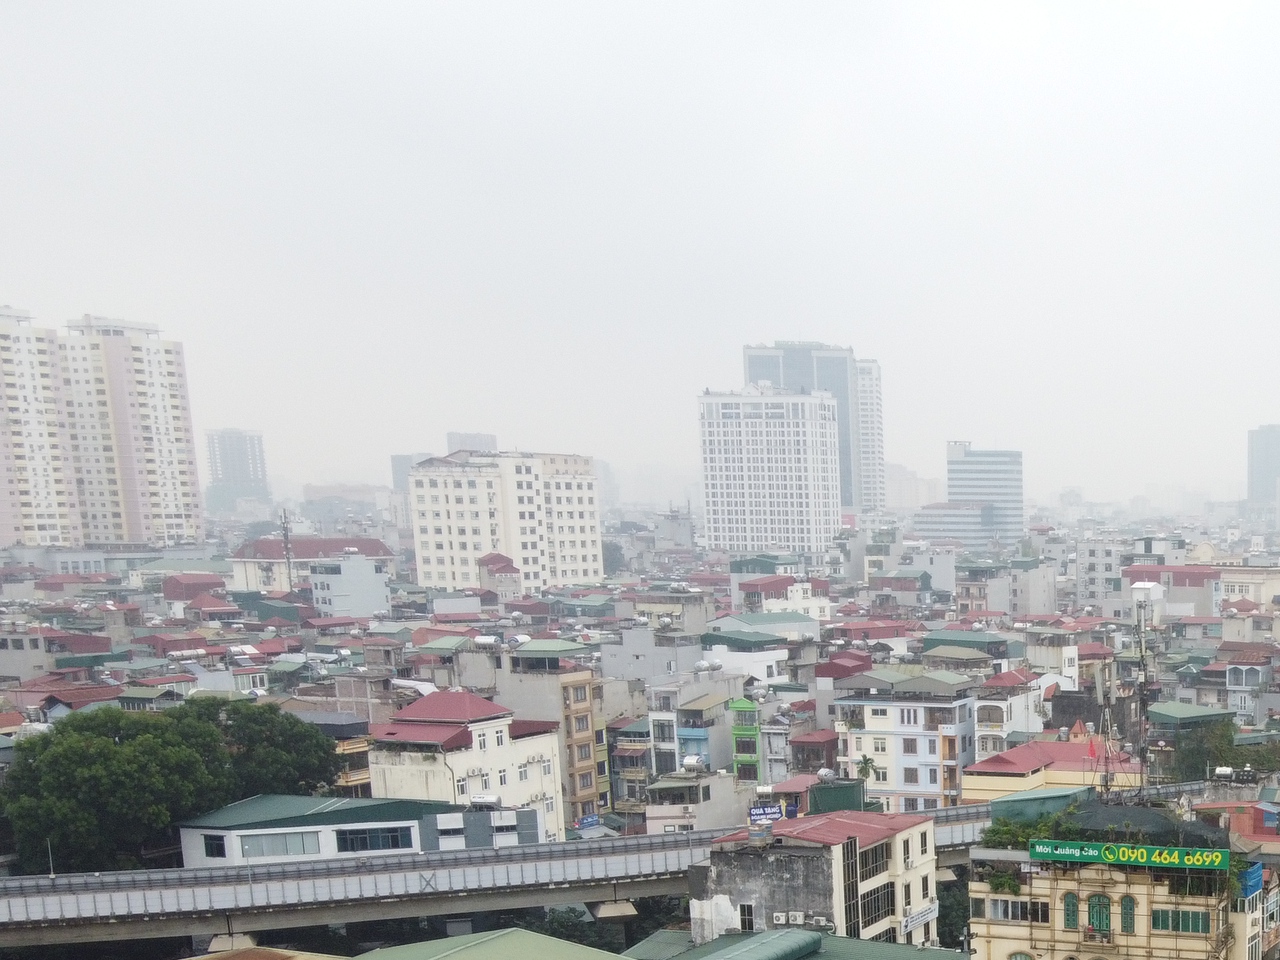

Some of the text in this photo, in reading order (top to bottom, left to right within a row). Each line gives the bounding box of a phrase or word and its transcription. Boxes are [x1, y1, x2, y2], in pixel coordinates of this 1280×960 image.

[1035, 844, 1051, 854] Mời
[1119, 847, 1222, 866] 090 464 6699
